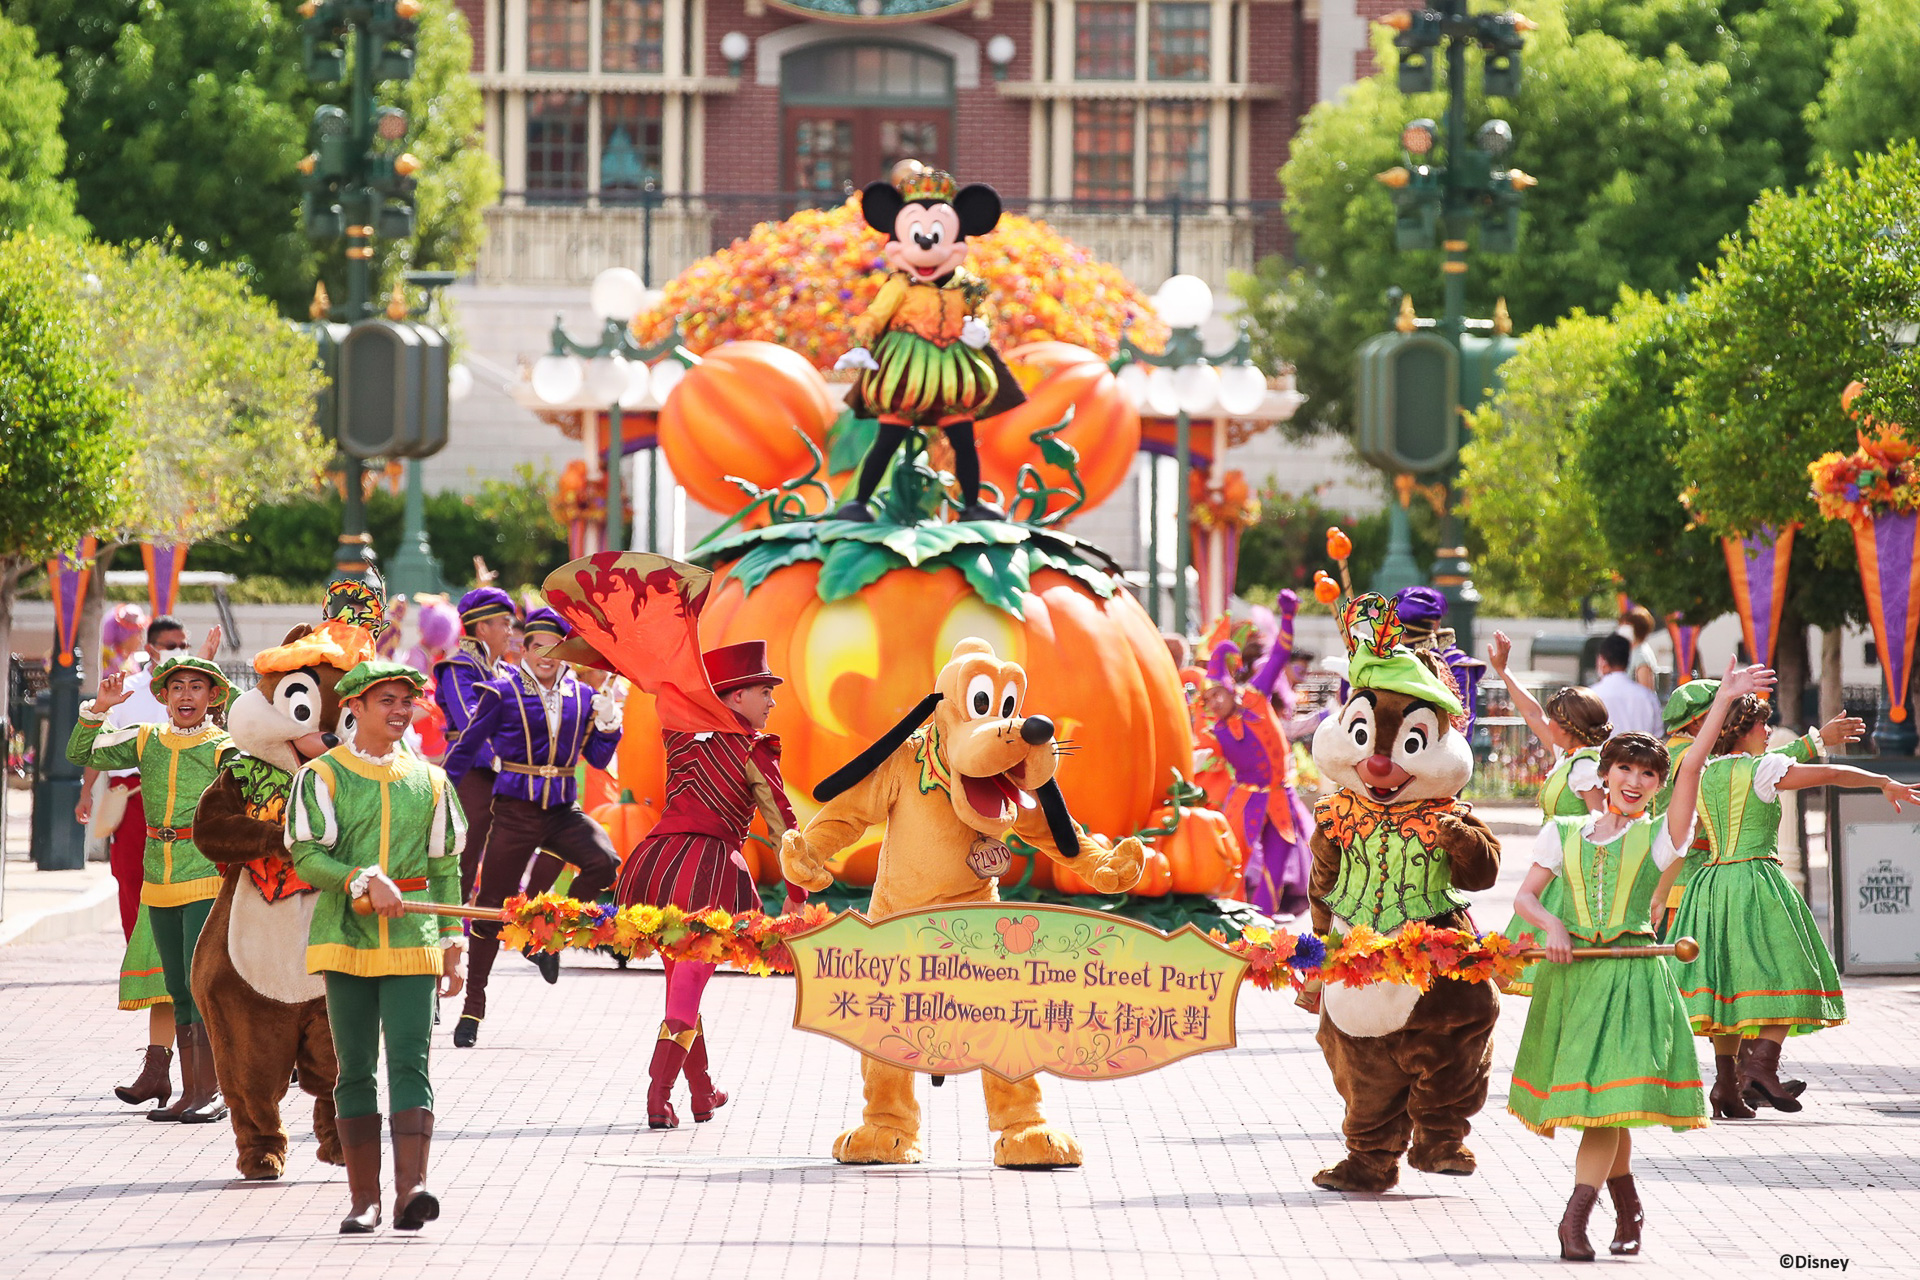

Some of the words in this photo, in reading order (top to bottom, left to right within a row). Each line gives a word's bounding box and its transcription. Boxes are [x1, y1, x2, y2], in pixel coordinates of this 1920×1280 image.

[972, 845, 1010, 870] PLUTO
[1867, 876, 1904, 885] MAIN
[1859, 886, 1912, 909] STREET
[814, 947, 911, 987] Mickey's
[917, 953, 1021, 983] Halloween
[1024, 960, 1077, 986] Time
[1083, 960, 1151, 988] Street
[1159, 965, 1224, 1001] Party
[828, 990, 898, 1023] 米奇
[901, 992, 1006, 1024] Halloween
[1009, 998, 1211, 1041] 玩轉大街派對
